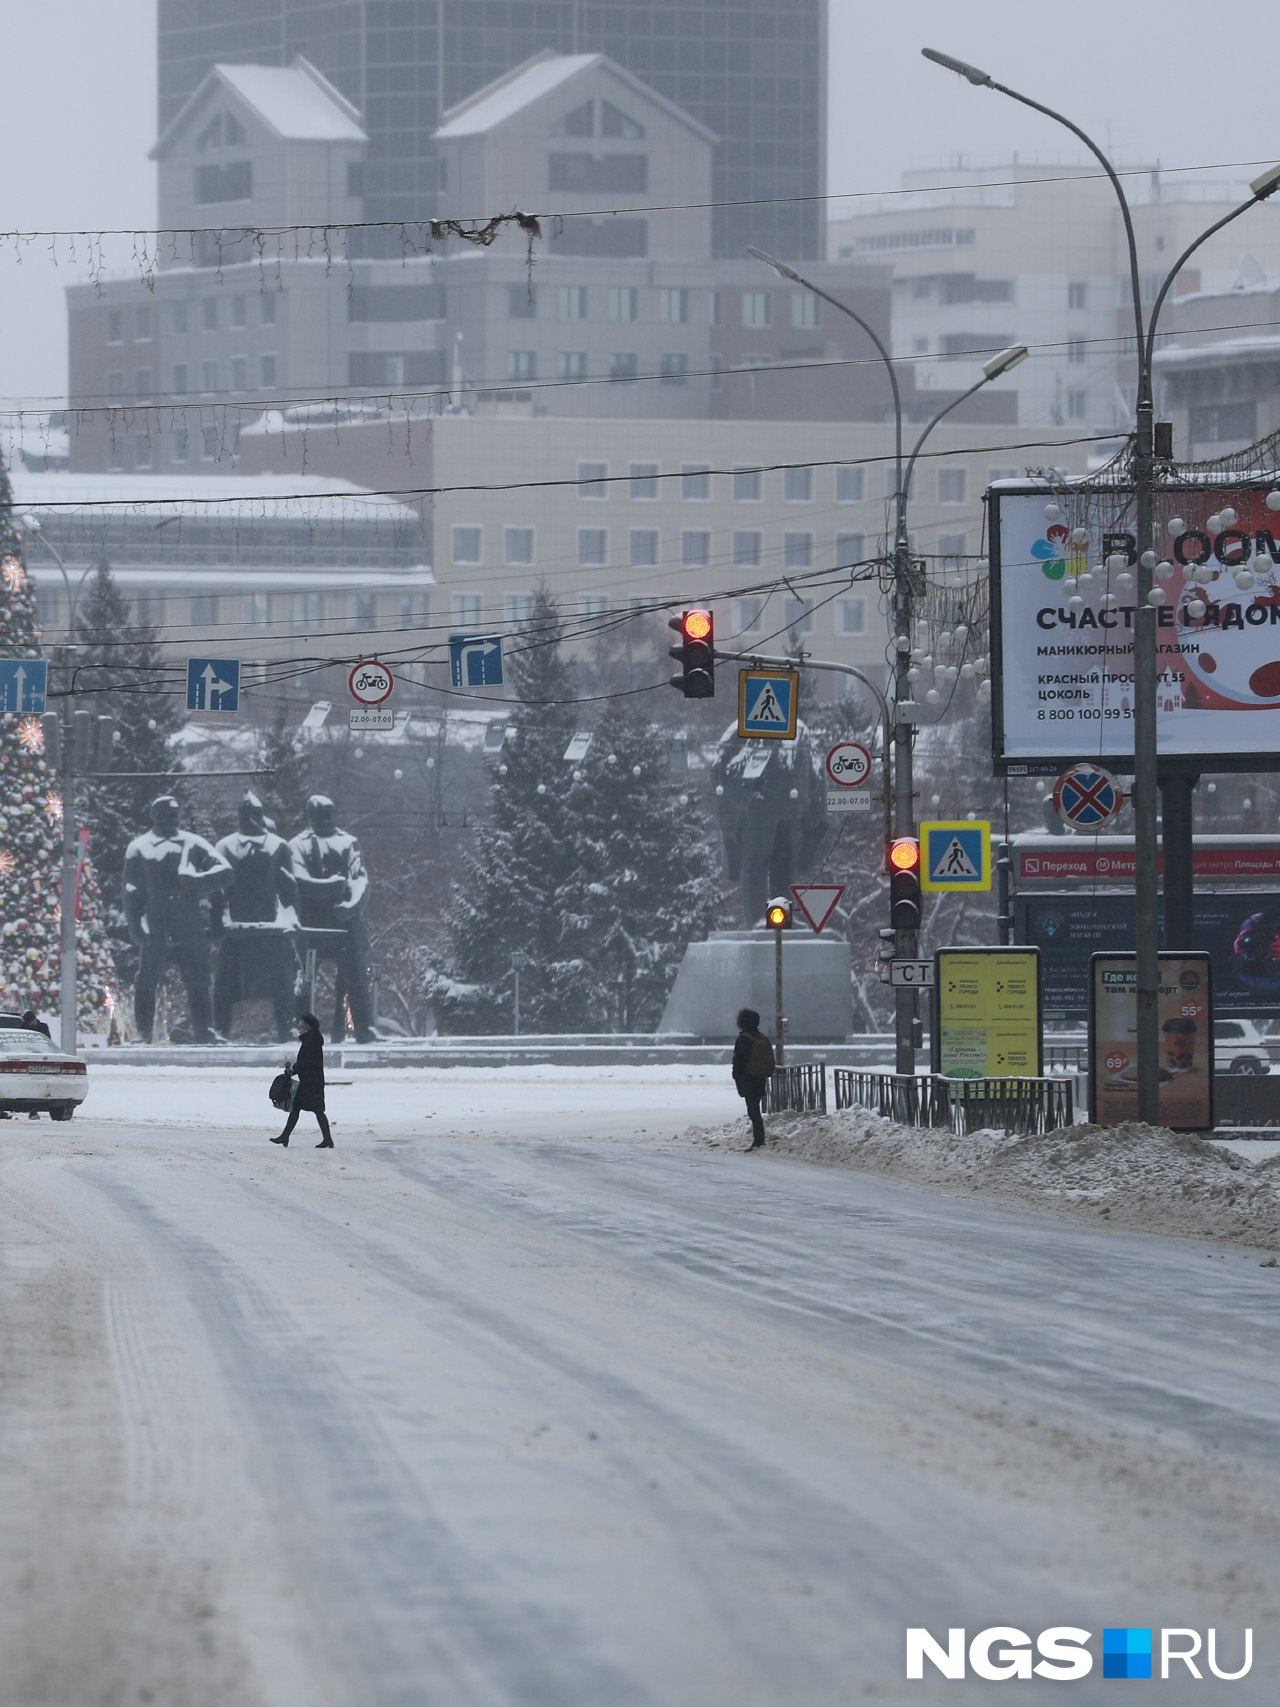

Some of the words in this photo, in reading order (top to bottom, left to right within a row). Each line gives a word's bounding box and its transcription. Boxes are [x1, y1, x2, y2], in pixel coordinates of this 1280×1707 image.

[1036, 606, 1174, 629] СЧАСТЕ
[1037, 643, 1135, 656] МАНИКЮРНЫЙ
[1038, 672, 1099, 684] КРАСНЫЙ
[1102, 674, 1168, 683] ПРОСКТ
[1172, 673, 1185, 682] 55
[1038, 690, 1090, 701] ЦОКОЛЬ
[1037, 710, 1045, 720] 8
[1049, 710, 1074, 720] 800
[1078, 709, 1101, 719] 100
[1105, 709, 1120, 719] 99
[1042, 861, 1087, 871] Переход
[1111, 861, 1136, 870] Метр
[1234, 860, 1273, 869] Площадь
[903, 965, 929, 982] СТ
[1104, 973, 1123, 982] Где
